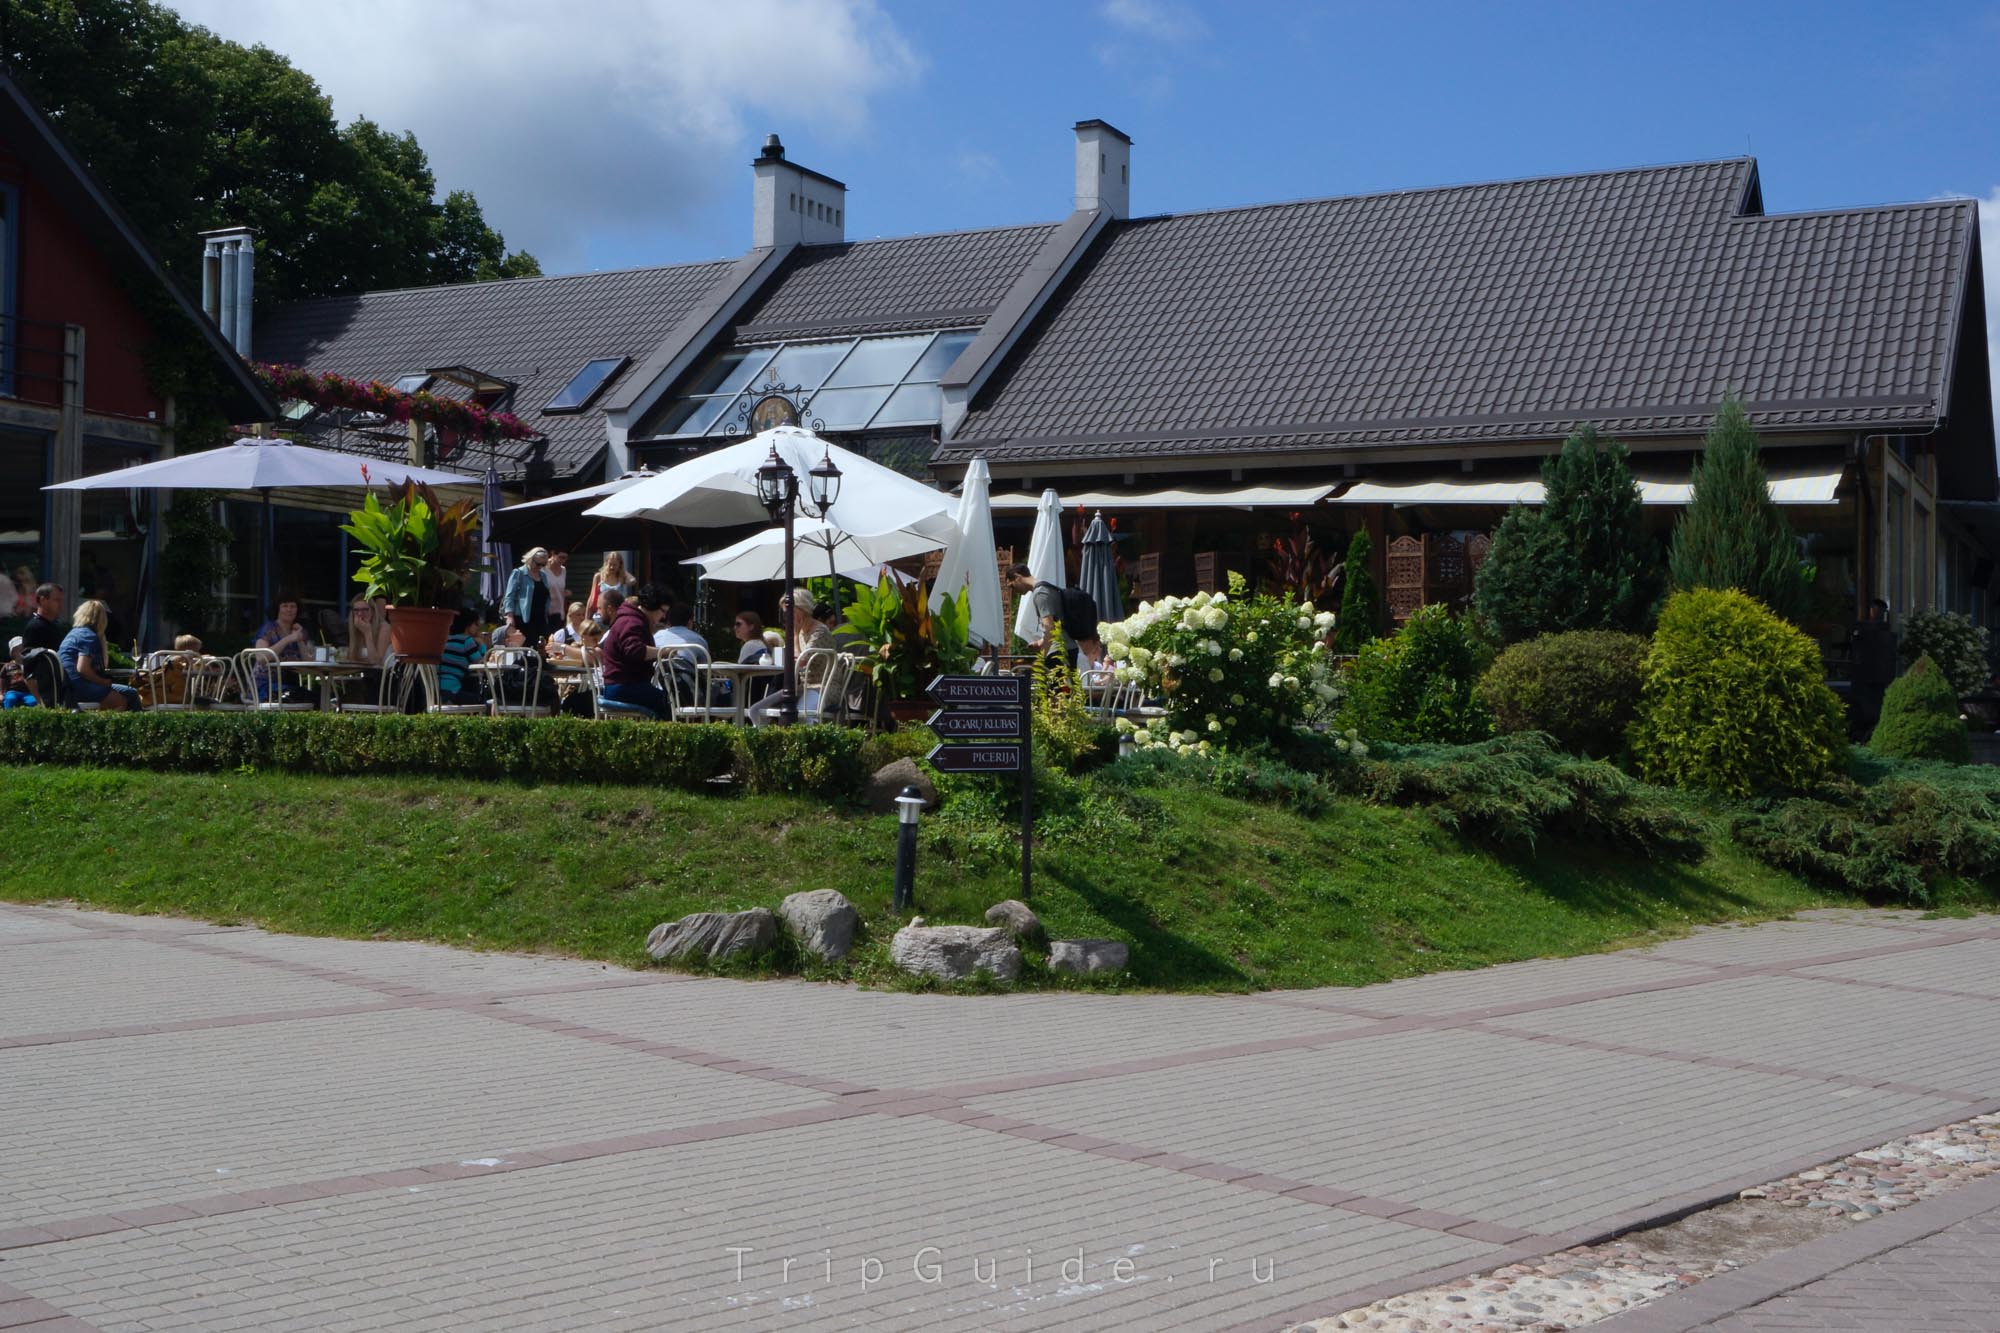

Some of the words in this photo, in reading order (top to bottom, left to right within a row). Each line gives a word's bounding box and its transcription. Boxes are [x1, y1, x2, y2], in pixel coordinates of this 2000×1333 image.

[950, 685, 1017, 696] RESTORANAS
[949, 719, 983, 731] CIGARŲ
[984, 719, 1017, 729] KLUBAS
[972, 752, 1016, 764] PICERIJA
